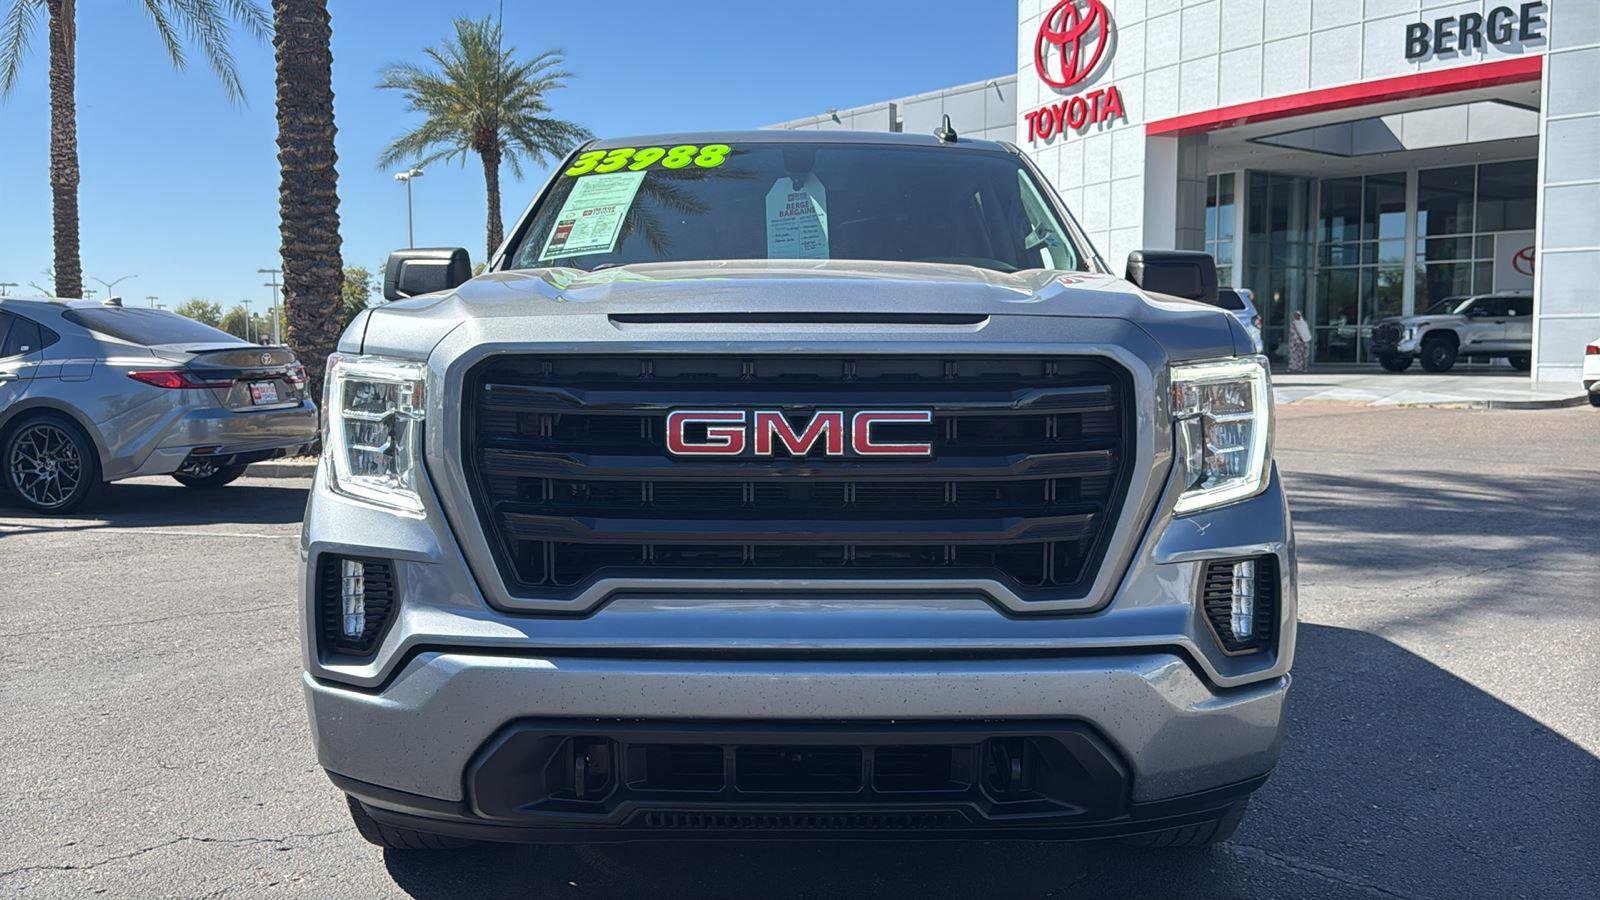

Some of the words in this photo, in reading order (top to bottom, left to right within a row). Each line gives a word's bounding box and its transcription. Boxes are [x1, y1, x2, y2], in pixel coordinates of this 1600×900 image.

[1405, 1, 1543, 59] BERGE
[1024, 86, 1124, 143] TOYOTA
[565, 144, 732, 177] 33988
[666, 411, 932, 455] GMC
